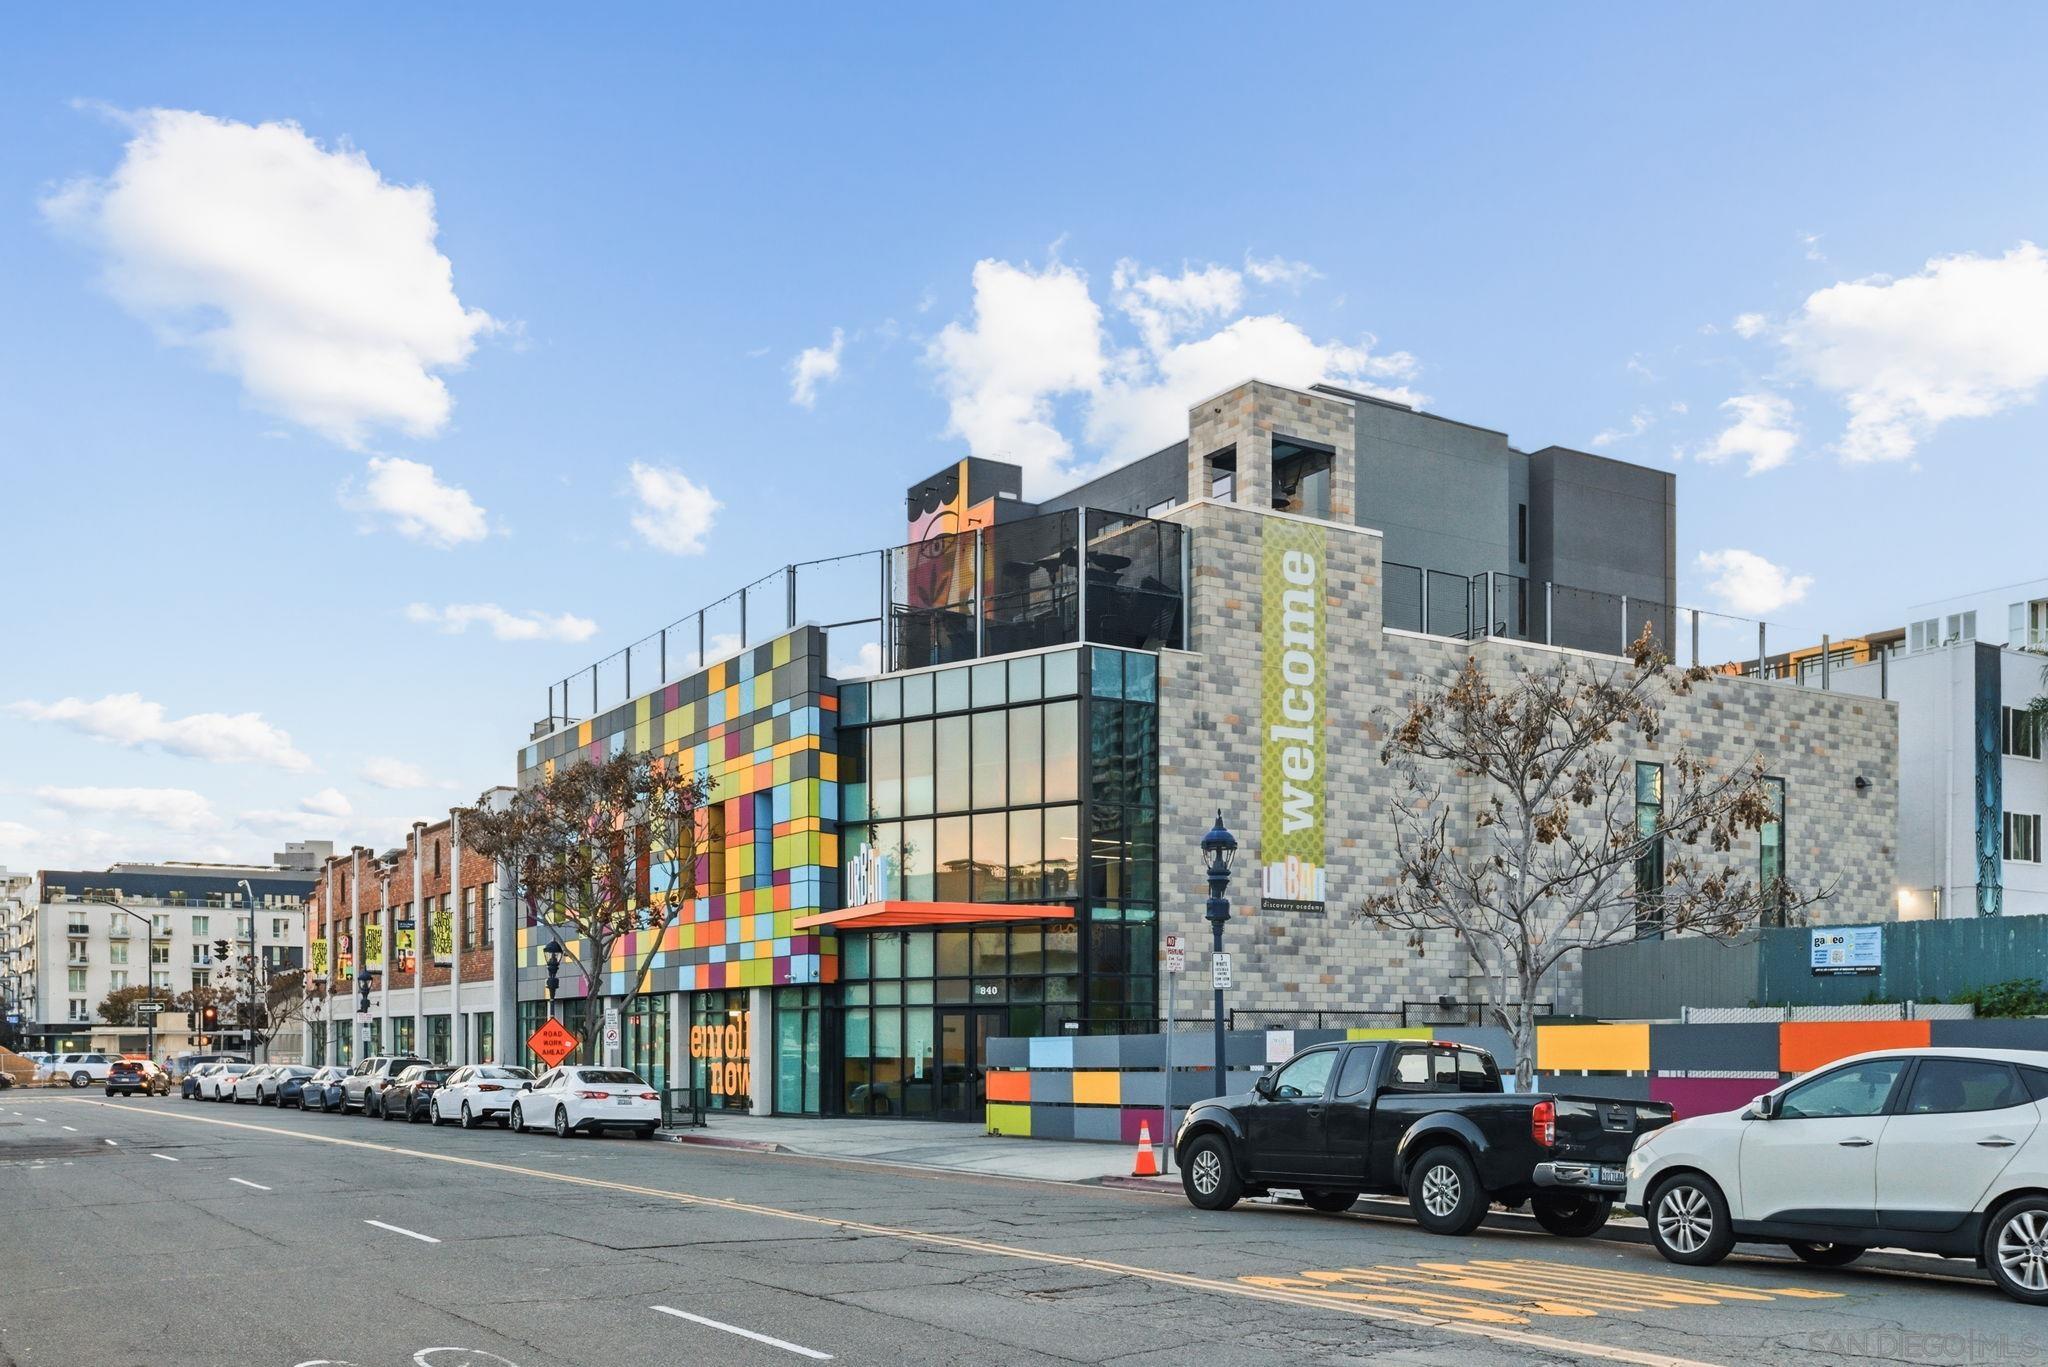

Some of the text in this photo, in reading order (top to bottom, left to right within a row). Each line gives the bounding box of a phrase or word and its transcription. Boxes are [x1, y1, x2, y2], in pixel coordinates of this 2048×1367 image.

[1271, 550, 1315, 835] welcome
[1262, 901, 1323, 912] discovery academy
[980, 986, 997, 995] 840
[690, 1010, 750, 1058] enroll
[710, 1061, 750, 1096] now
